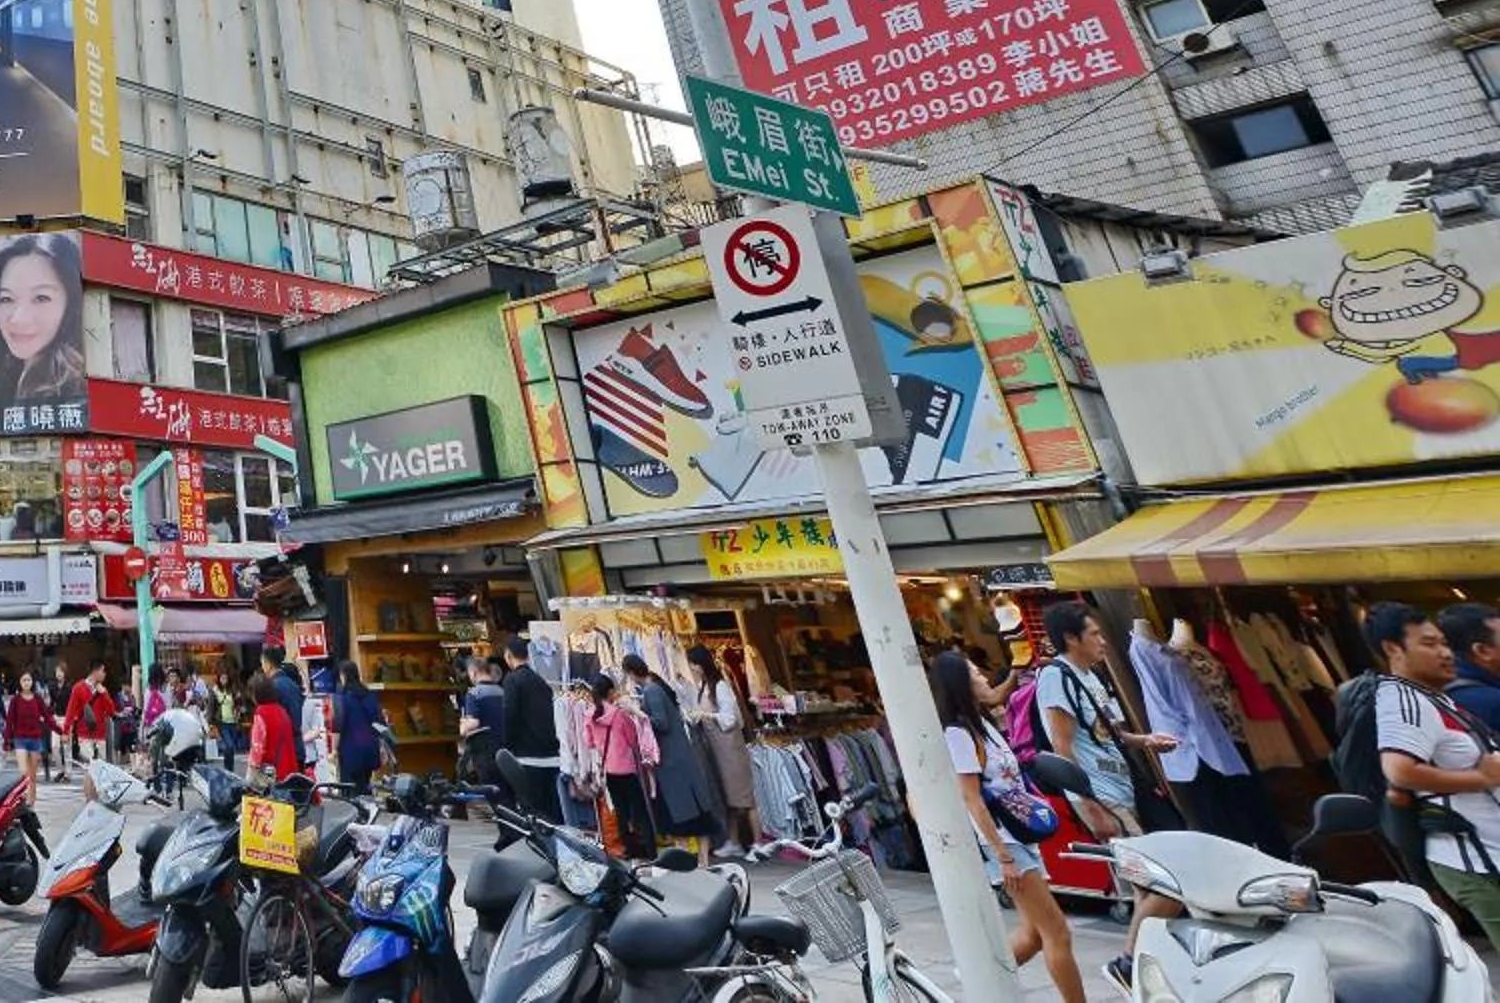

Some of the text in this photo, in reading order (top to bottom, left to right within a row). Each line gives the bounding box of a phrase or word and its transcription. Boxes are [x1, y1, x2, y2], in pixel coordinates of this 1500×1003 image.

[1002, 15, 1110, 69] 李小姐
[84, 41, 112, 158] aboard
[704, 92, 830, 167] 峨眉街
[721, 147, 791, 193] EMei
[743, 238, 782, 279] 停
[184, 263, 268, 301] 港式飲茶
[755, 340, 843, 368] SIDEWALK
[762, 411, 856, 436] TOW-AWAY ZONE
[812, 427, 841, 442] 110
[371, 440, 467, 482] YAGER
[182, 528, 205, 542] 300
